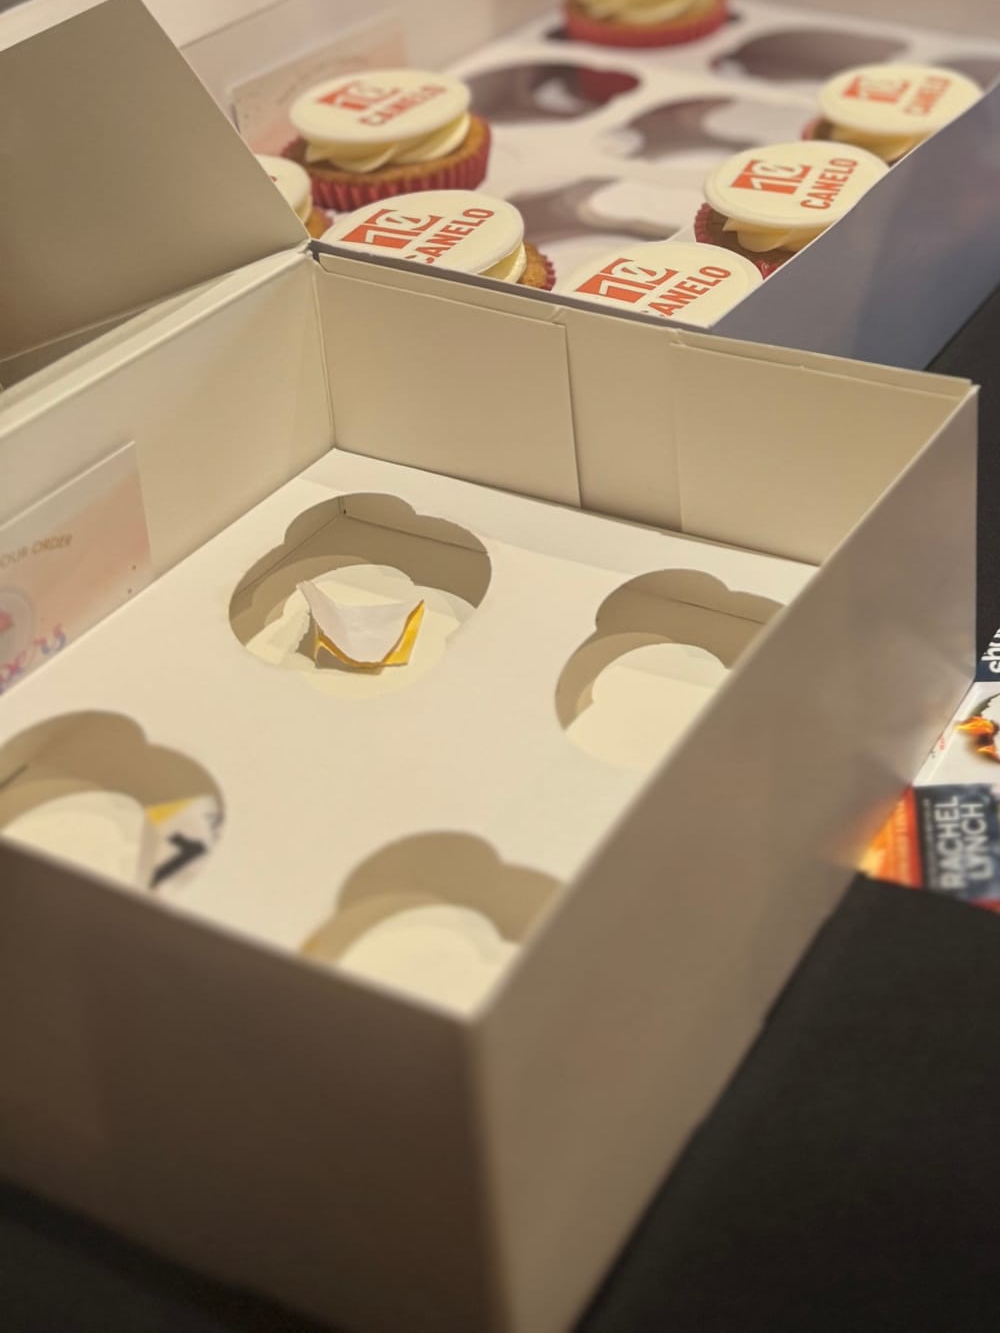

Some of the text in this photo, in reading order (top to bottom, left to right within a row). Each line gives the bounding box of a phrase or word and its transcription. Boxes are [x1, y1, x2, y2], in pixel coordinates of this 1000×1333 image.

[358, 83, 448, 127] CANELO
[800, 156, 860, 211] CANELO
[406, 207, 495, 264] ANELO
[643, 265, 732, 317] ANELO
[31, 534, 73, 555] ORDER
[935, 796, 966, 889] RACHEL
[960, 803, 995, 880] LYNCH
